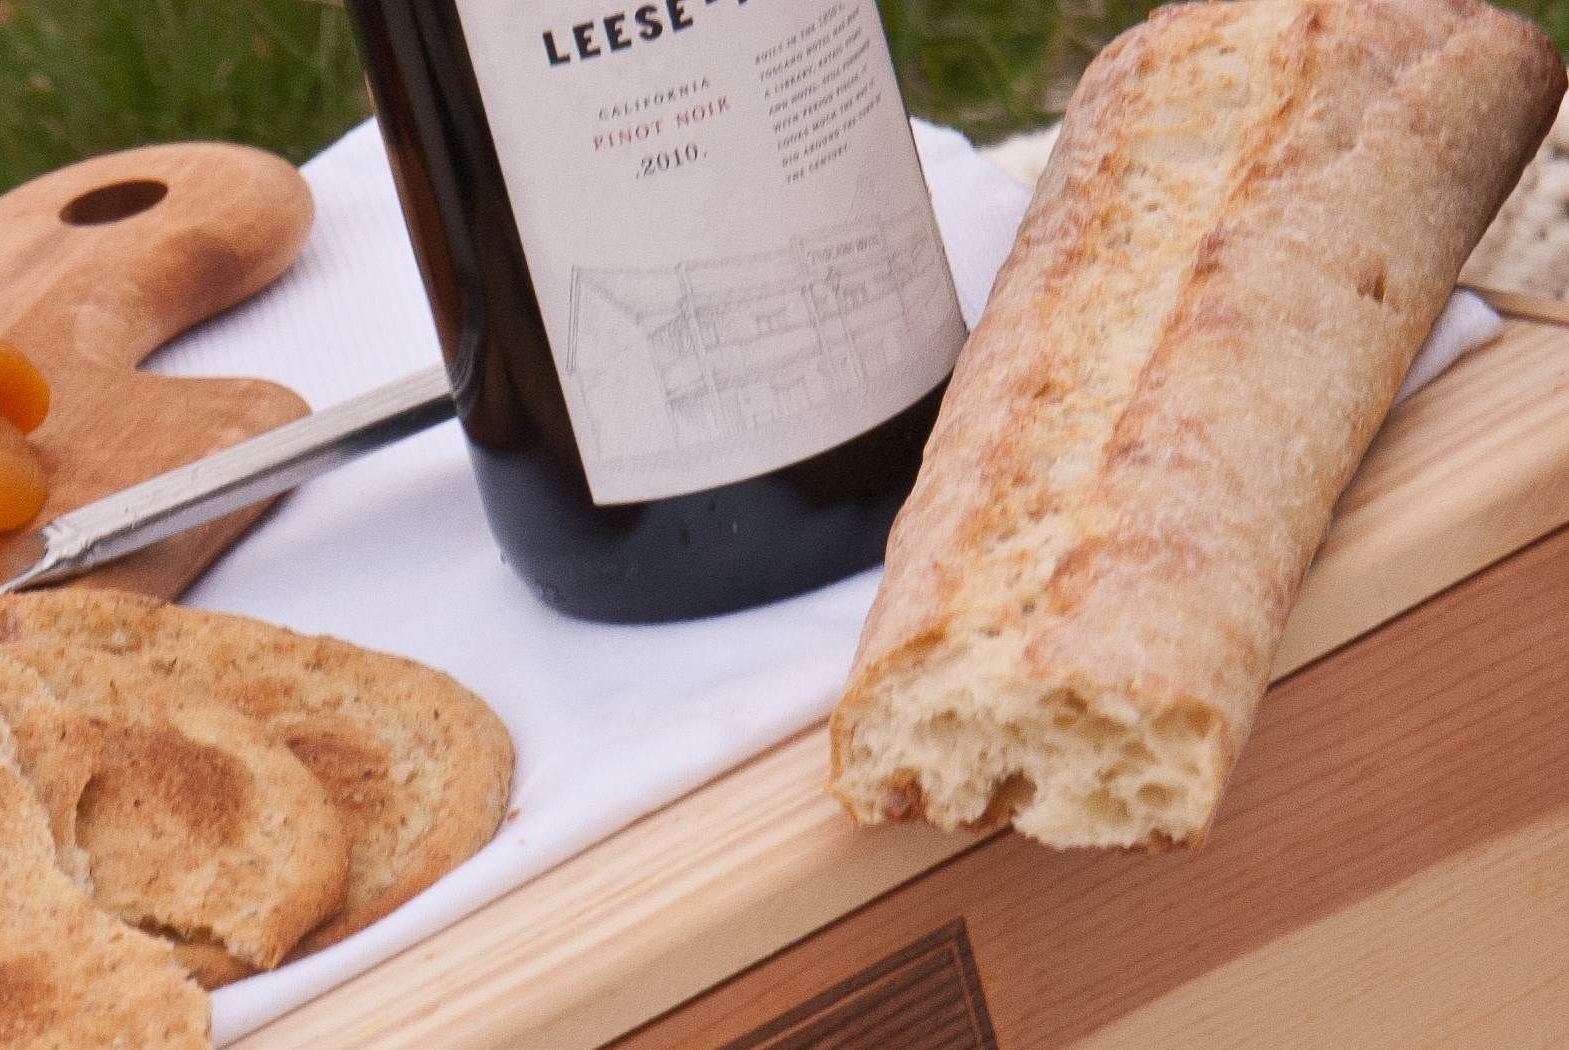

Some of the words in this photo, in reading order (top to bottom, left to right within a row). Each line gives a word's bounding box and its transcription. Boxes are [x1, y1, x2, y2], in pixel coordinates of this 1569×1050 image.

[598, 76, 710, 121] CALIFORNIA
[591, 118, 662, 152] PINOT
[675, 96, 731, 129] NOIR
